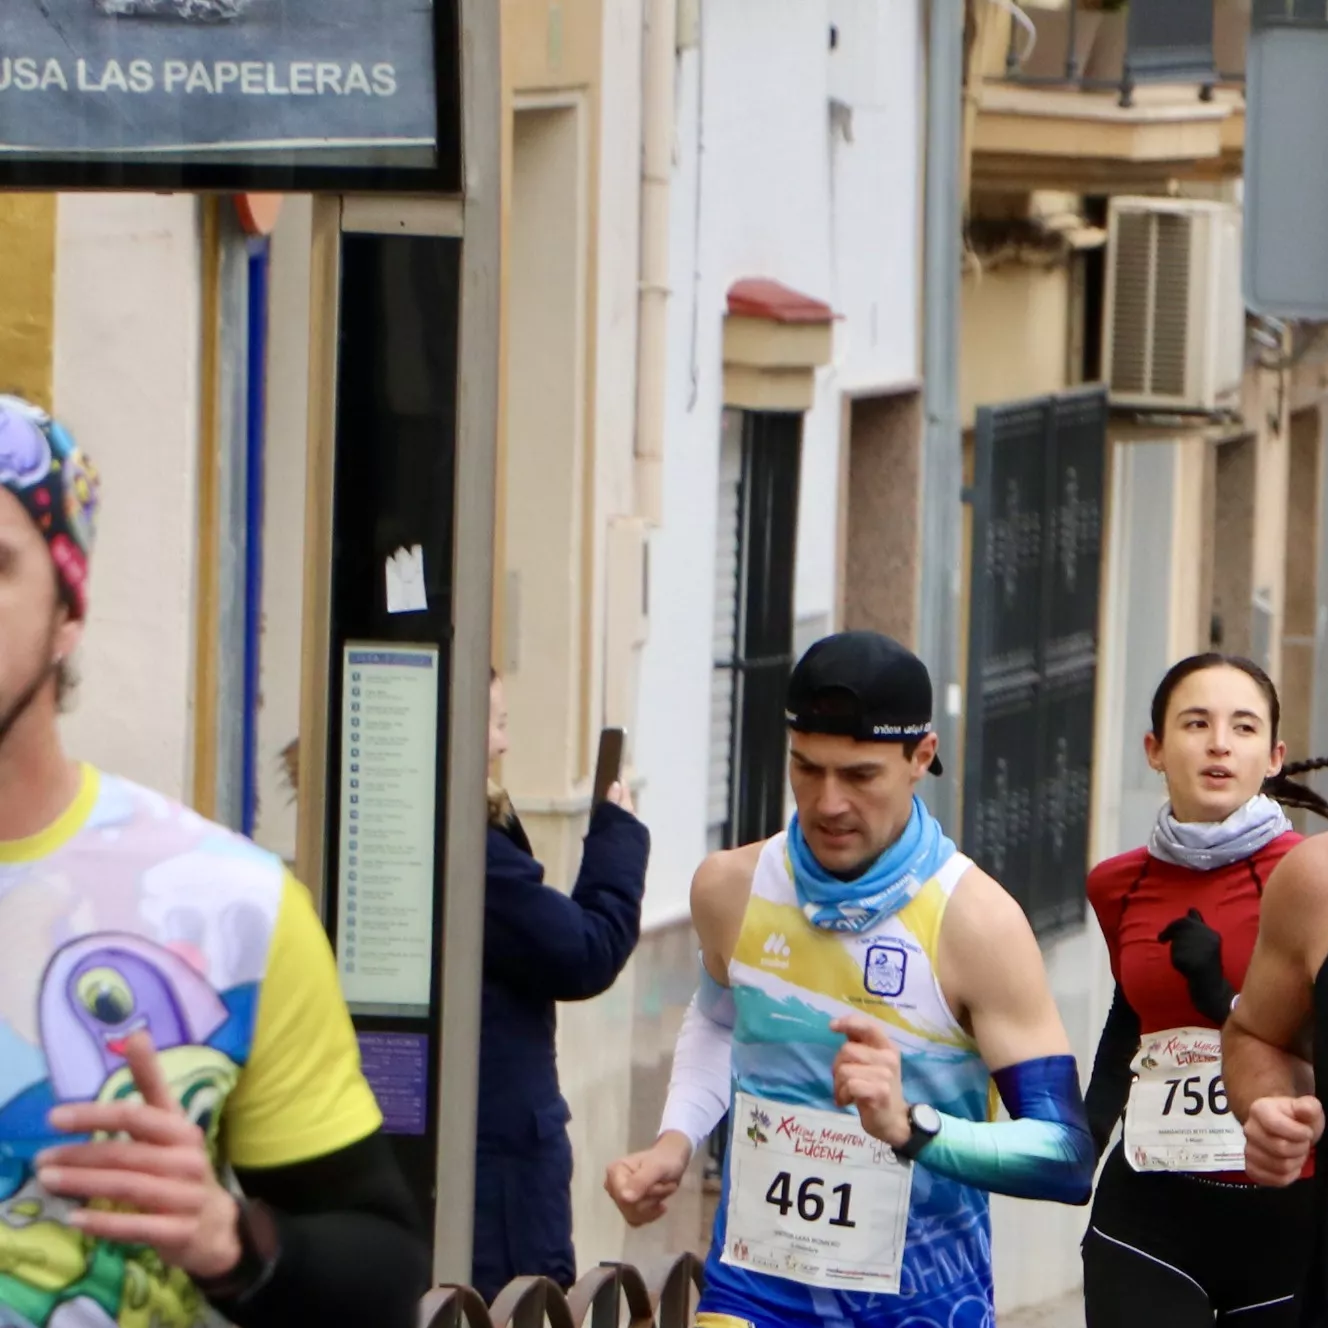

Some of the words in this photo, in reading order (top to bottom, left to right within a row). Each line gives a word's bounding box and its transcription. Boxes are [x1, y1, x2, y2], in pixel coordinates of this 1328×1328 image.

[77, 59, 155, 93] LAS
[163, 61, 397, 96] PAPELERAS
[1162, 1075, 1229, 1116] 756
[795, 1138, 849, 1164] LUCENA
[766, 1171, 856, 1228] 461
